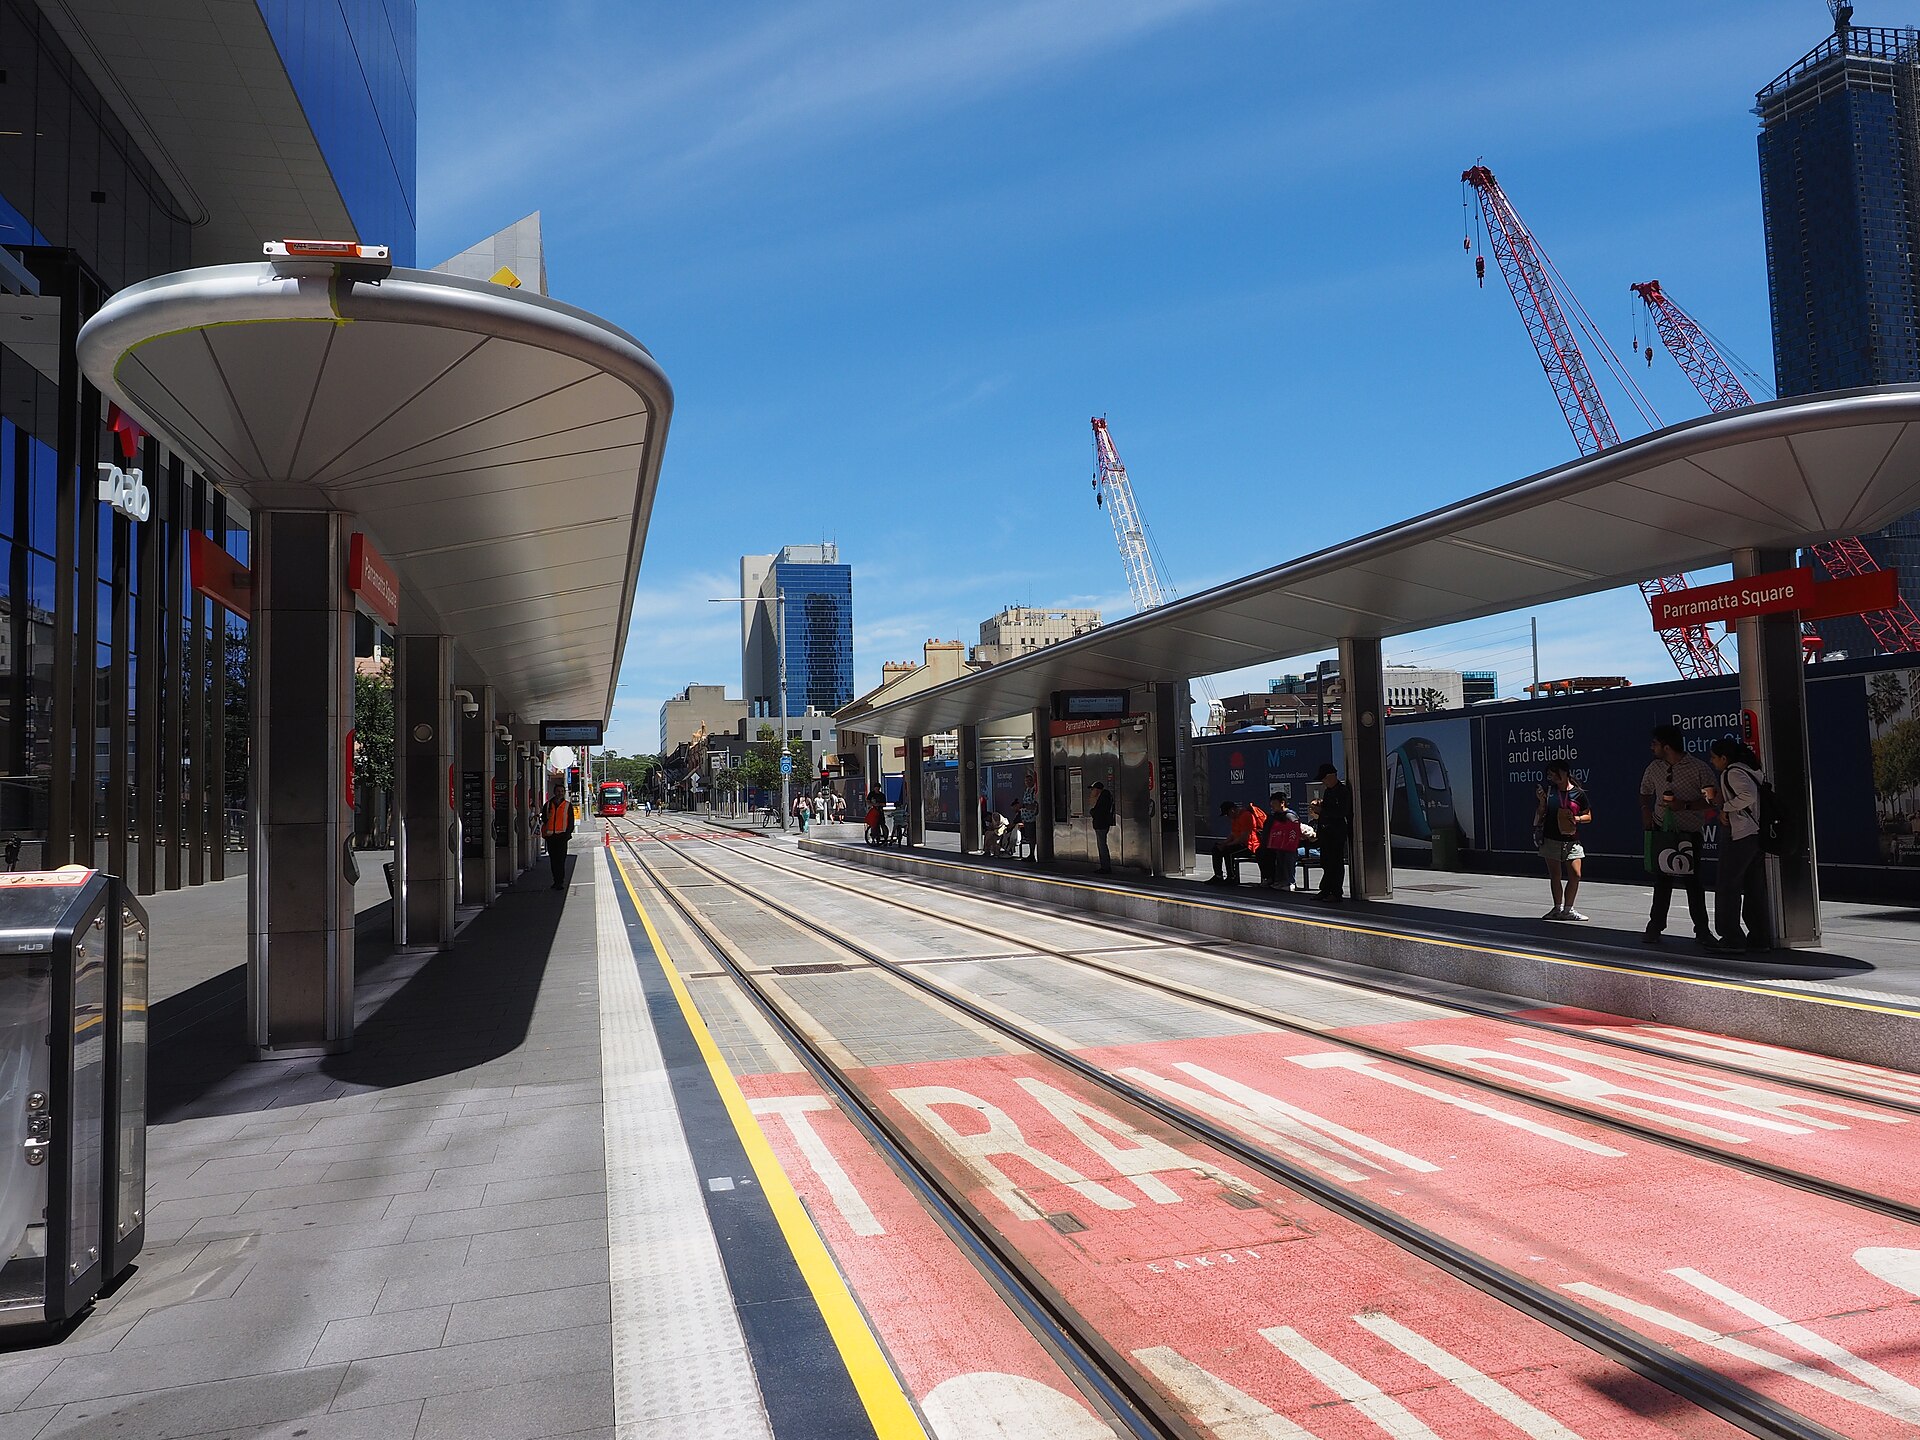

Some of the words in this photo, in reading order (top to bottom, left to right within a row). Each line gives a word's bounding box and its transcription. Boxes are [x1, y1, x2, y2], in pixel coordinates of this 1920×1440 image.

[98, 463, 150, 521] nab
[365, 556, 387, 599] Parramatta
[386, 580, 397, 609] Square
[1663, 594, 1739, 619] Parramatta
[1741, 585, 1794, 607] Square
[1066, 719, 1085, 731] Parramatta
[1085, 719, 1100, 730] Square
[1672, 709, 1743, 730] Parramat
[1508, 729, 1517, 744] A
[1519, 728, 1545, 743] fast,
[1547, 724, 1575, 741] safe
[1508, 747, 1530, 764] and
[1532, 744, 1578, 762] reliable
[1231, 769, 1245, 780] NSW
[1509, 768, 1543, 783] metro
[744, 1061, 1444, 1238] TRAM
